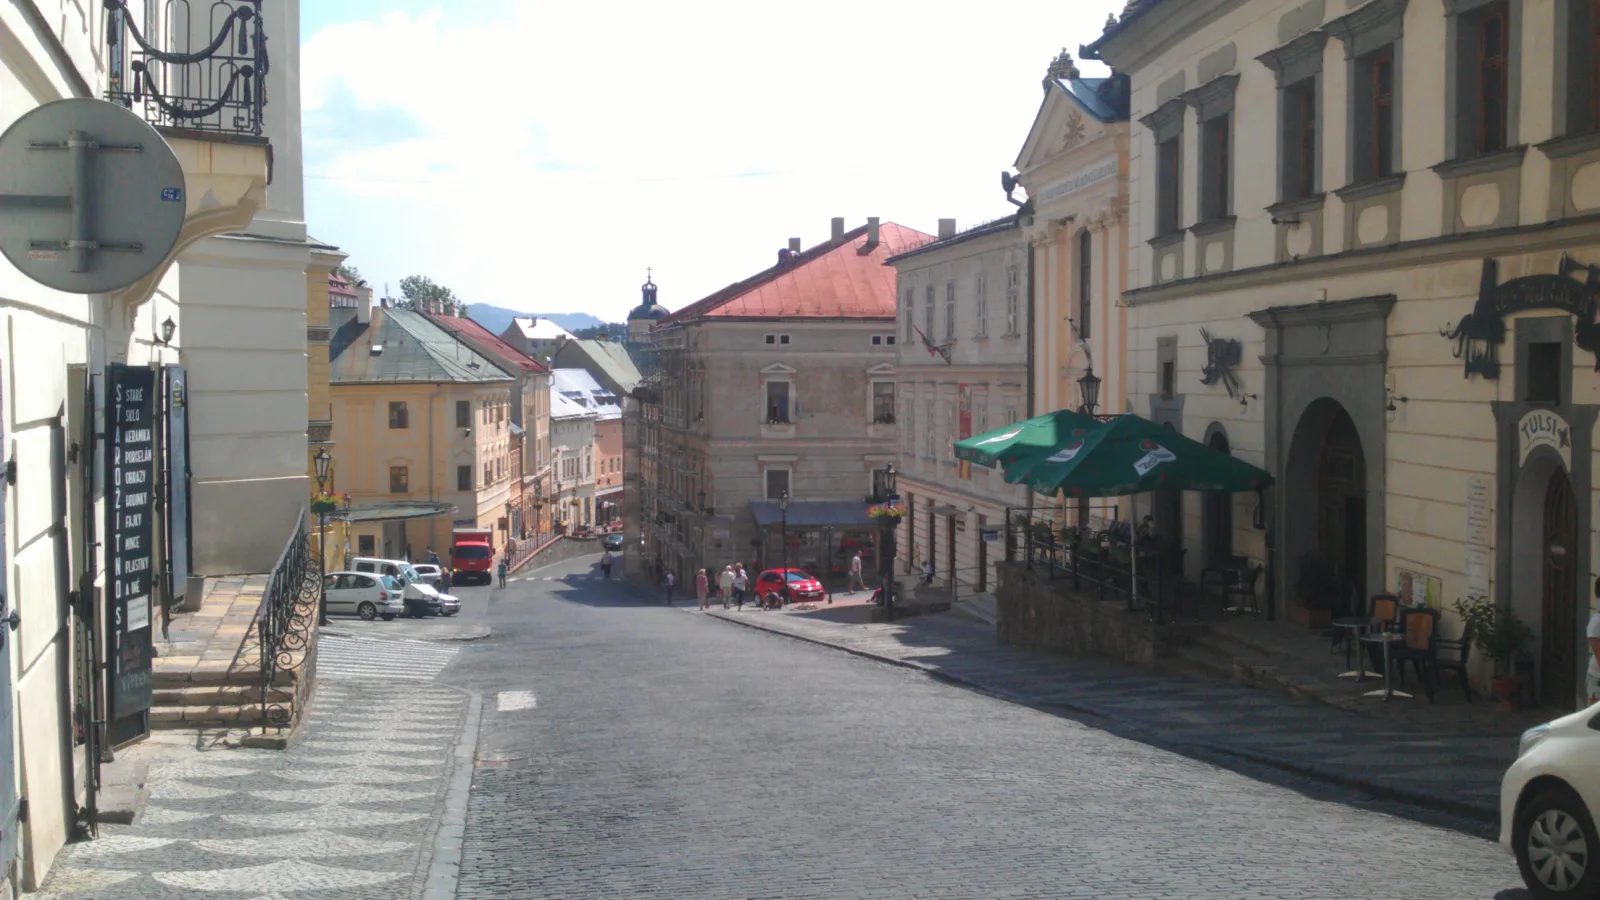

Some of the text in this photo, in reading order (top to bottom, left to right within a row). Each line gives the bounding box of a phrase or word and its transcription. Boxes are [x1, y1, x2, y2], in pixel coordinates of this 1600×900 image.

[125, 386, 144, 402] STARÉ
[125, 408, 140, 422] SKLO
[1520, 414, 1557, 440] TULSI
[124, 428, 151, 443] KERAMIKA
[124, 447, 152, 464] PORCELÁN
[125, 470, 146, 485] OBRAZY
[125, 491, 148, 508] HODINKY
[125, 513, 143, 529] FAJKY
[125, 535, 141, 551] MINCE
[124, 556, 149, 574] PLASTIKY
[125, 583, 130, 597] A
